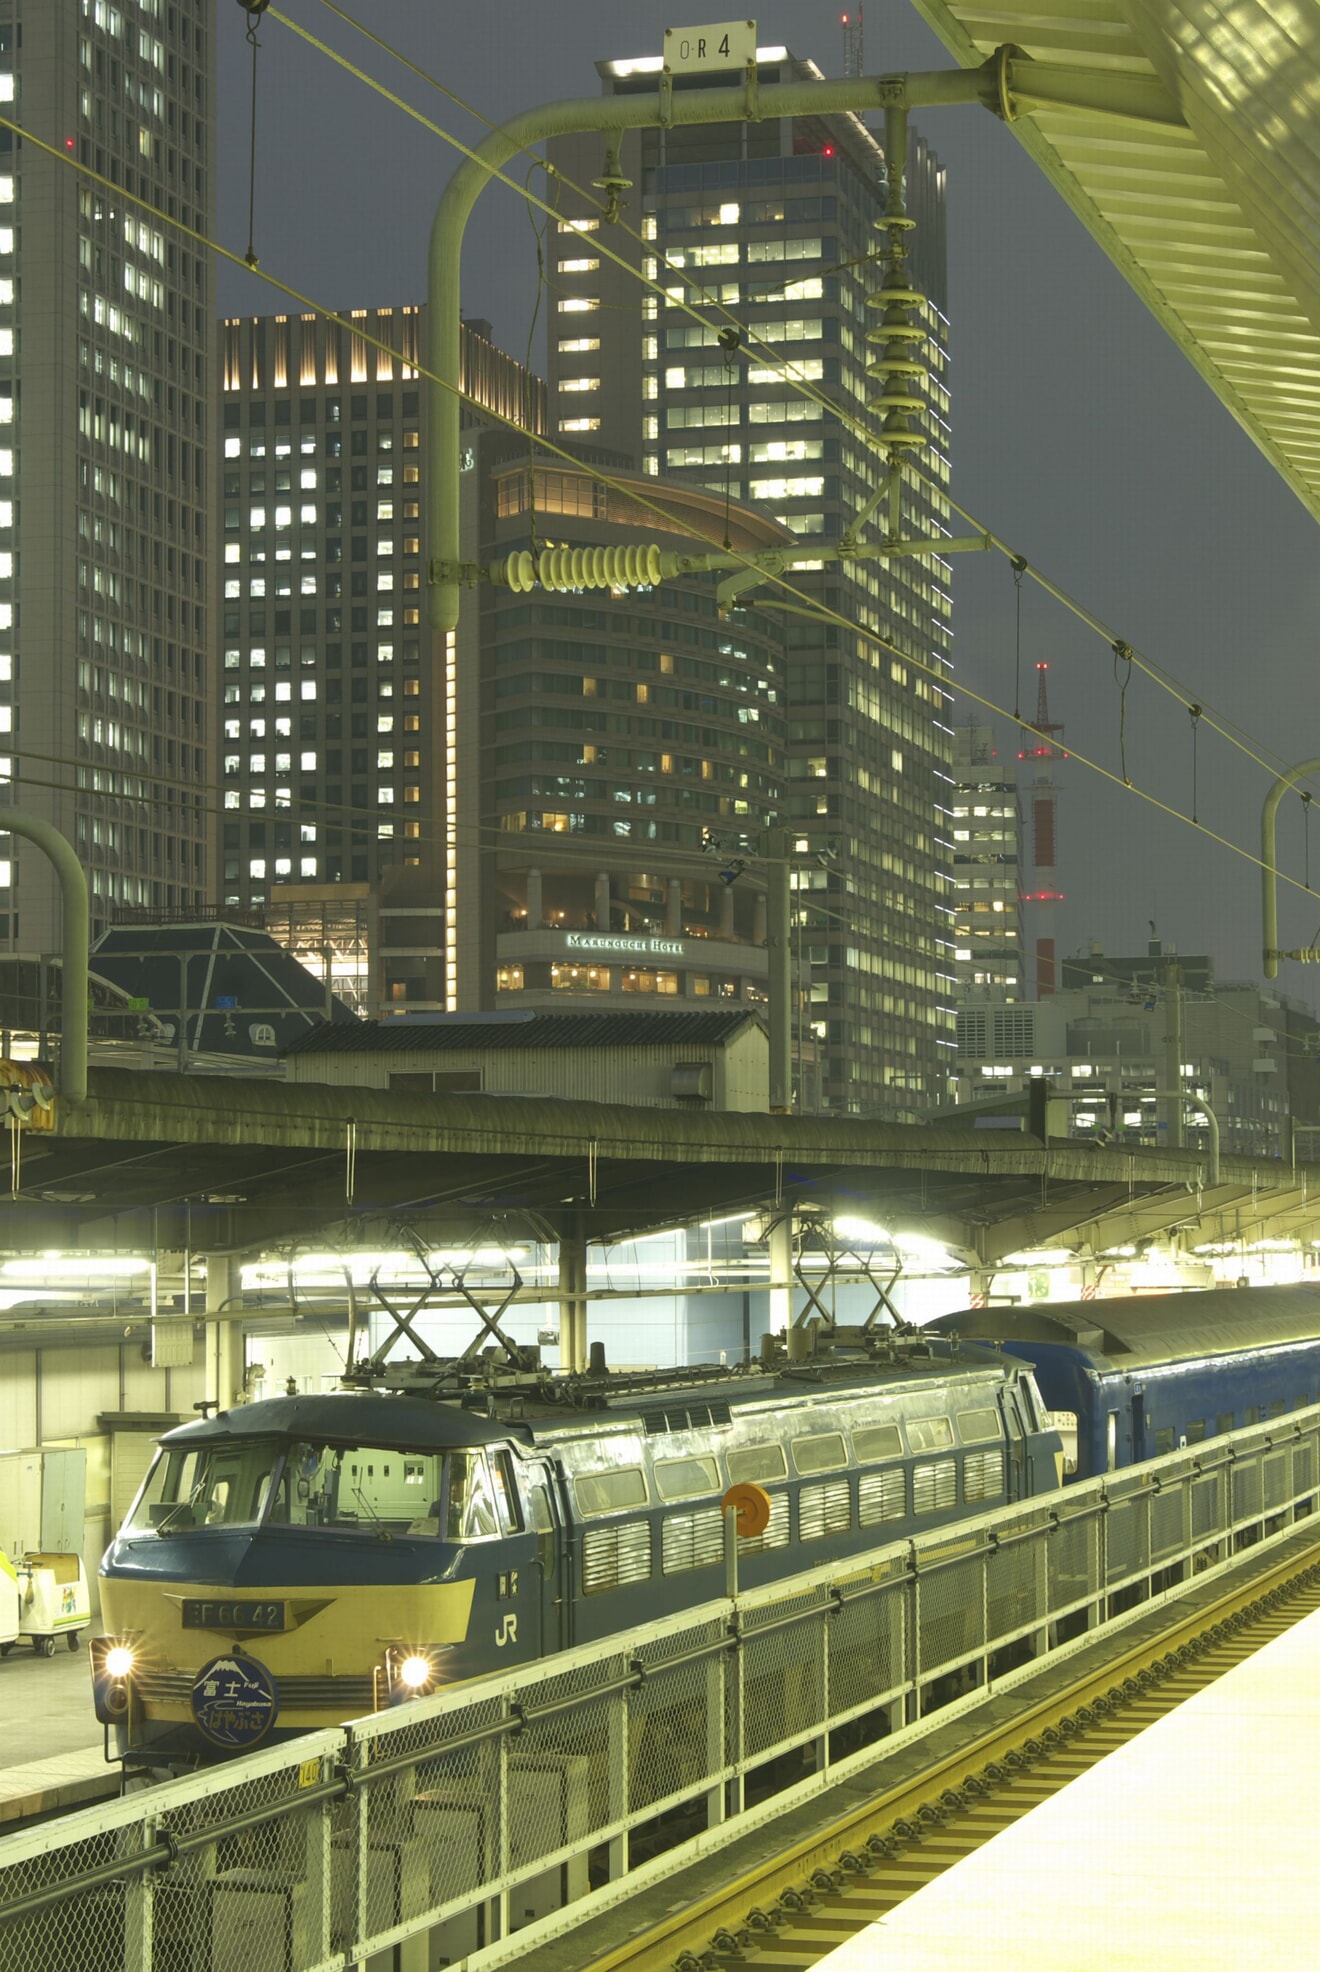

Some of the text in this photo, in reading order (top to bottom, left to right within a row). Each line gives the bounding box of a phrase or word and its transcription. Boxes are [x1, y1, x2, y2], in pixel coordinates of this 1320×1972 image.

[718, 33, 730, 57] 4
[495, 1613, 517, 1647] JR
[203, 1680, 241, 1697] 富士
[208, 1710, 264, 1730] はやぶさ
